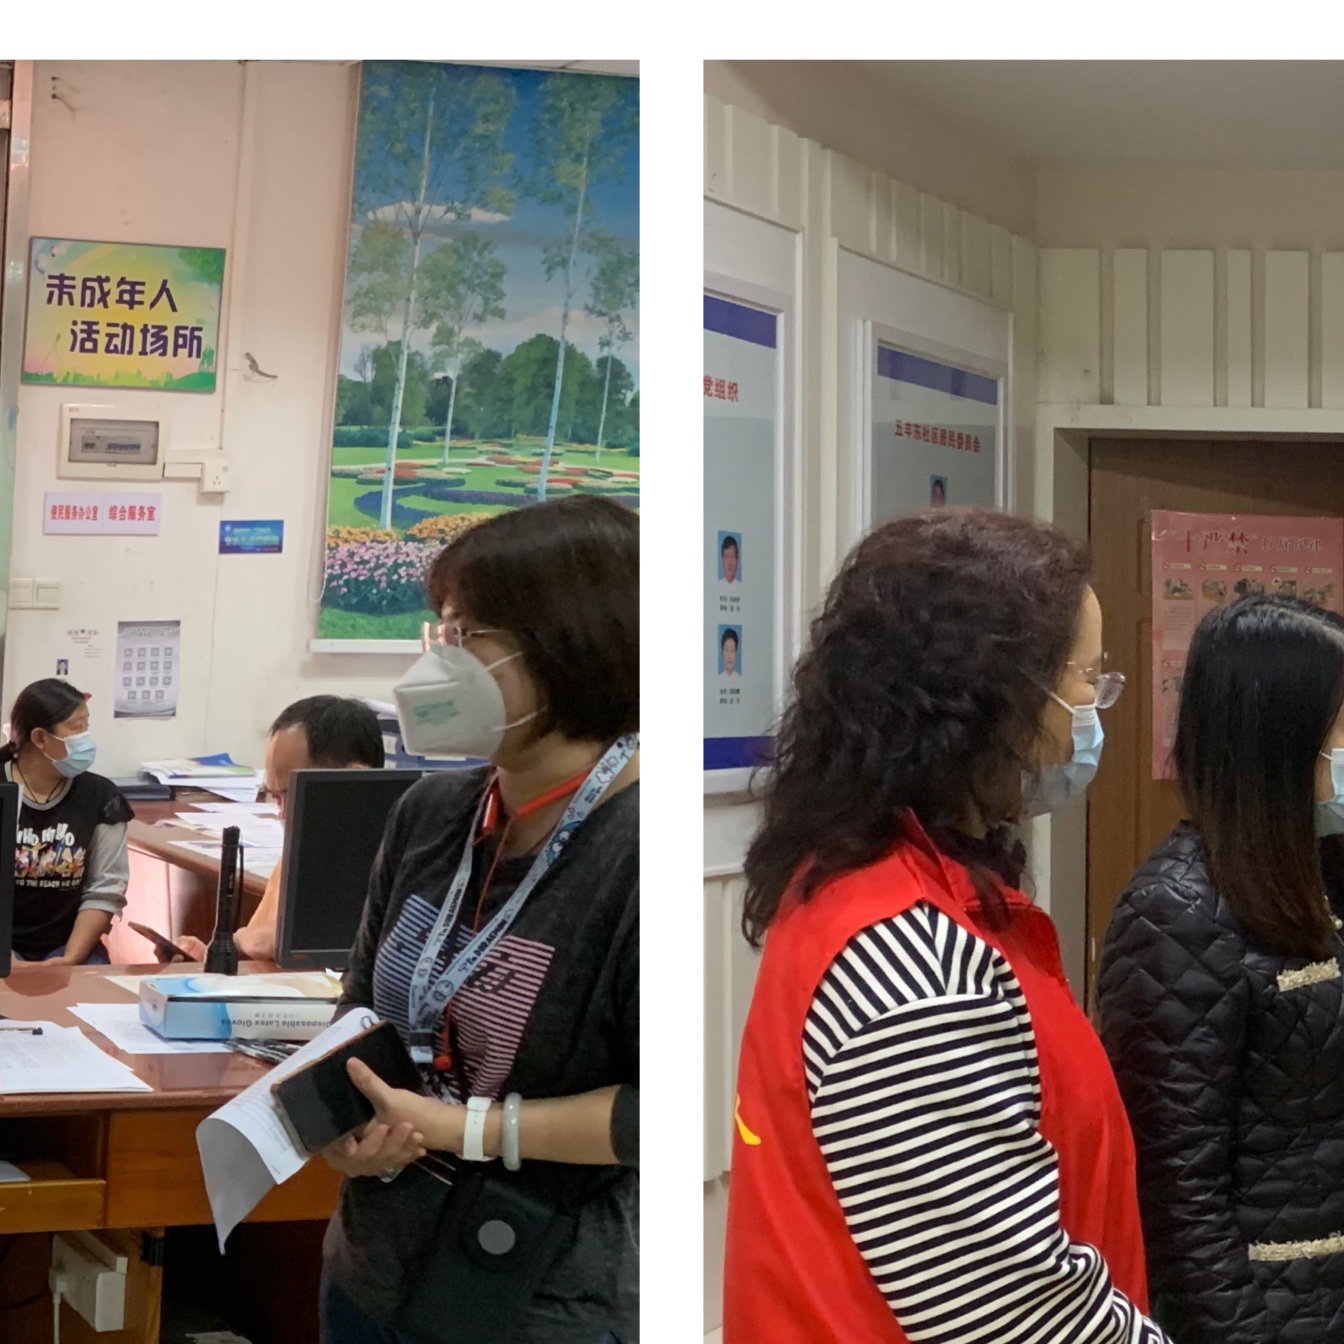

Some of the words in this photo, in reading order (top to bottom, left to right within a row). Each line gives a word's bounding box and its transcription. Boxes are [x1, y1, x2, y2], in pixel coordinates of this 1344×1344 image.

[46, 273, 178, 313] 未成年人
[69, 320, 204, 359] 活动场所
[703, 375, 739, 402] 党组织
[50, 505, 99, 521] 便民服务办公室
[108, 505, 156, 521] 综合服务室
[221, 1018, 252, 1028] Gloves
[254, 1019, 280, 1027] Latex
